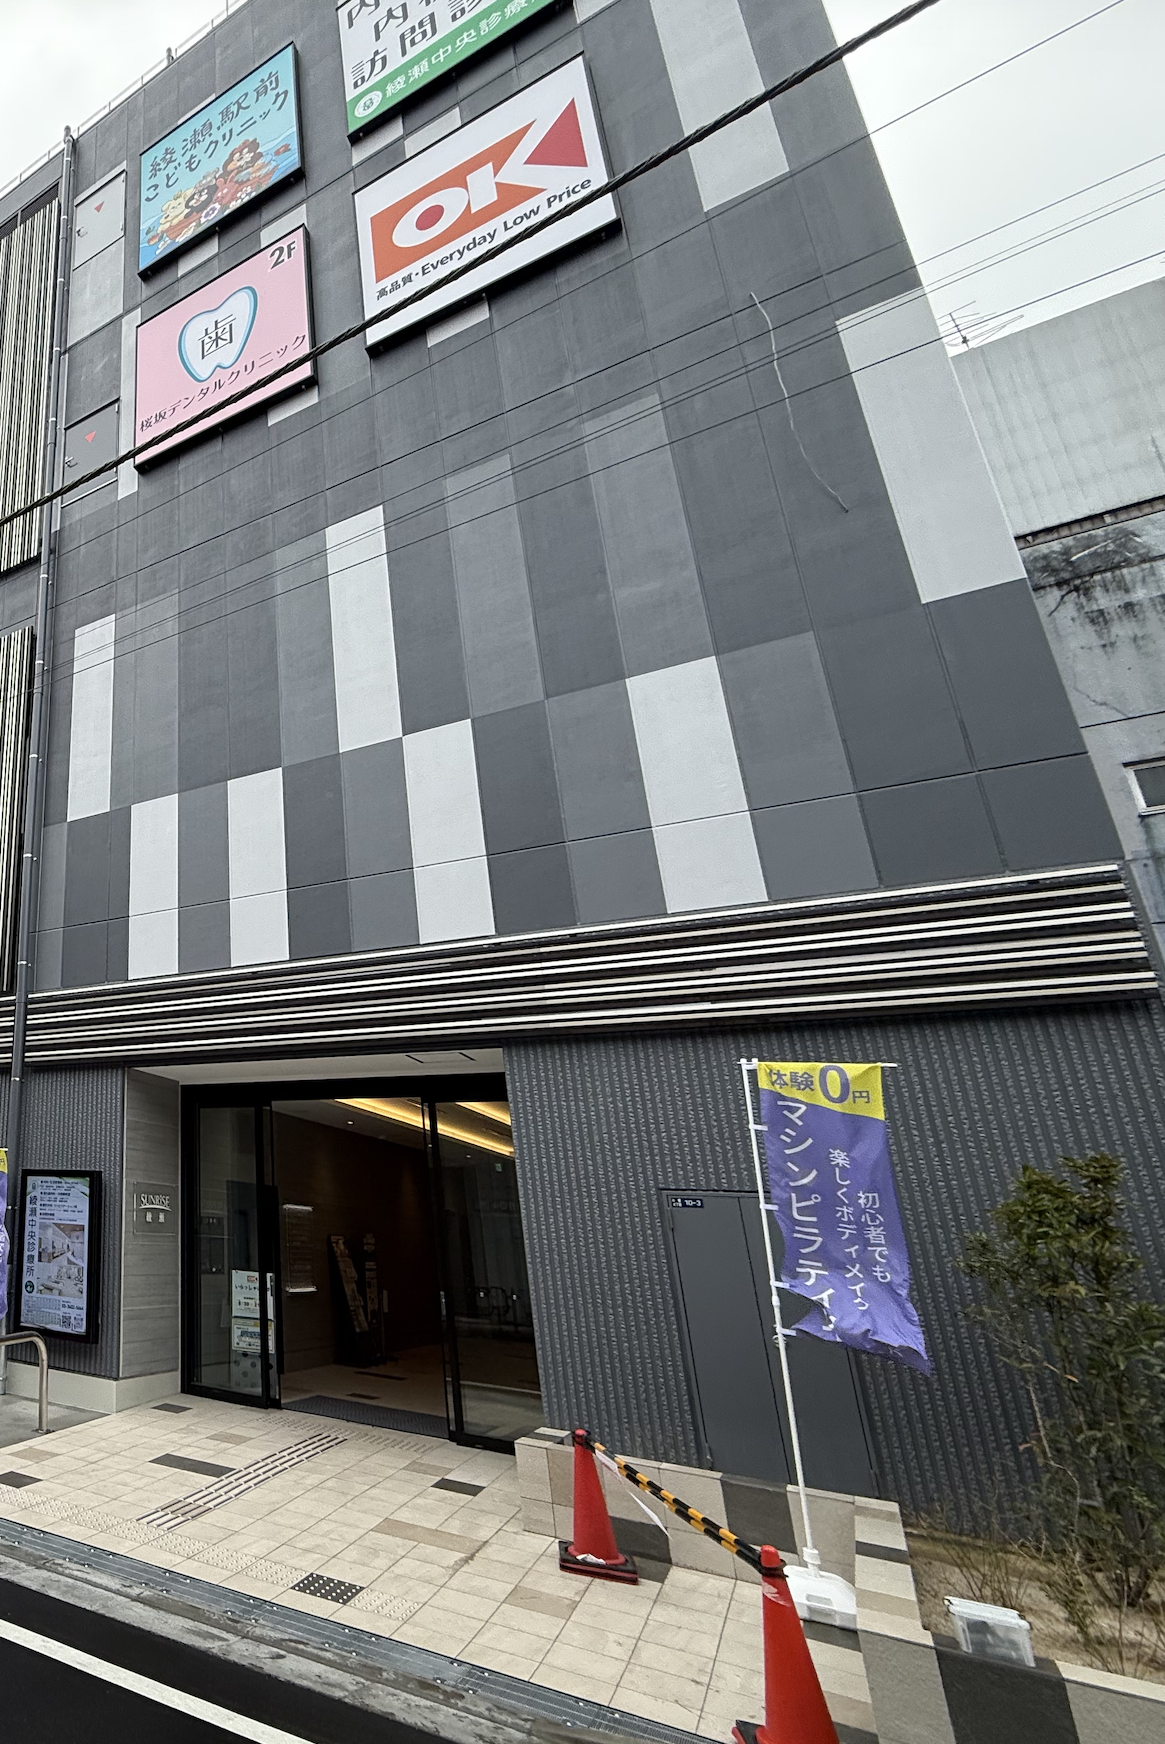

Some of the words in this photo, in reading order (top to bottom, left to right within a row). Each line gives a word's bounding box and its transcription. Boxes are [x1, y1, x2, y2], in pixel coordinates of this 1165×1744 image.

[145, 89, 289, 202] こどもクリニック
[148, 71, 280, 180] 綾瀬駅前
[503, 204, 540, 232] Low
[546, 179, 592, 208] Price
[268, 240, 296, 270] 2F
[139, 334, 307, 432] 桜坂デンタルクリニック
[198, 313, 237, 361] 歯
[857, 1190, 891, 1283] 初心者でも
